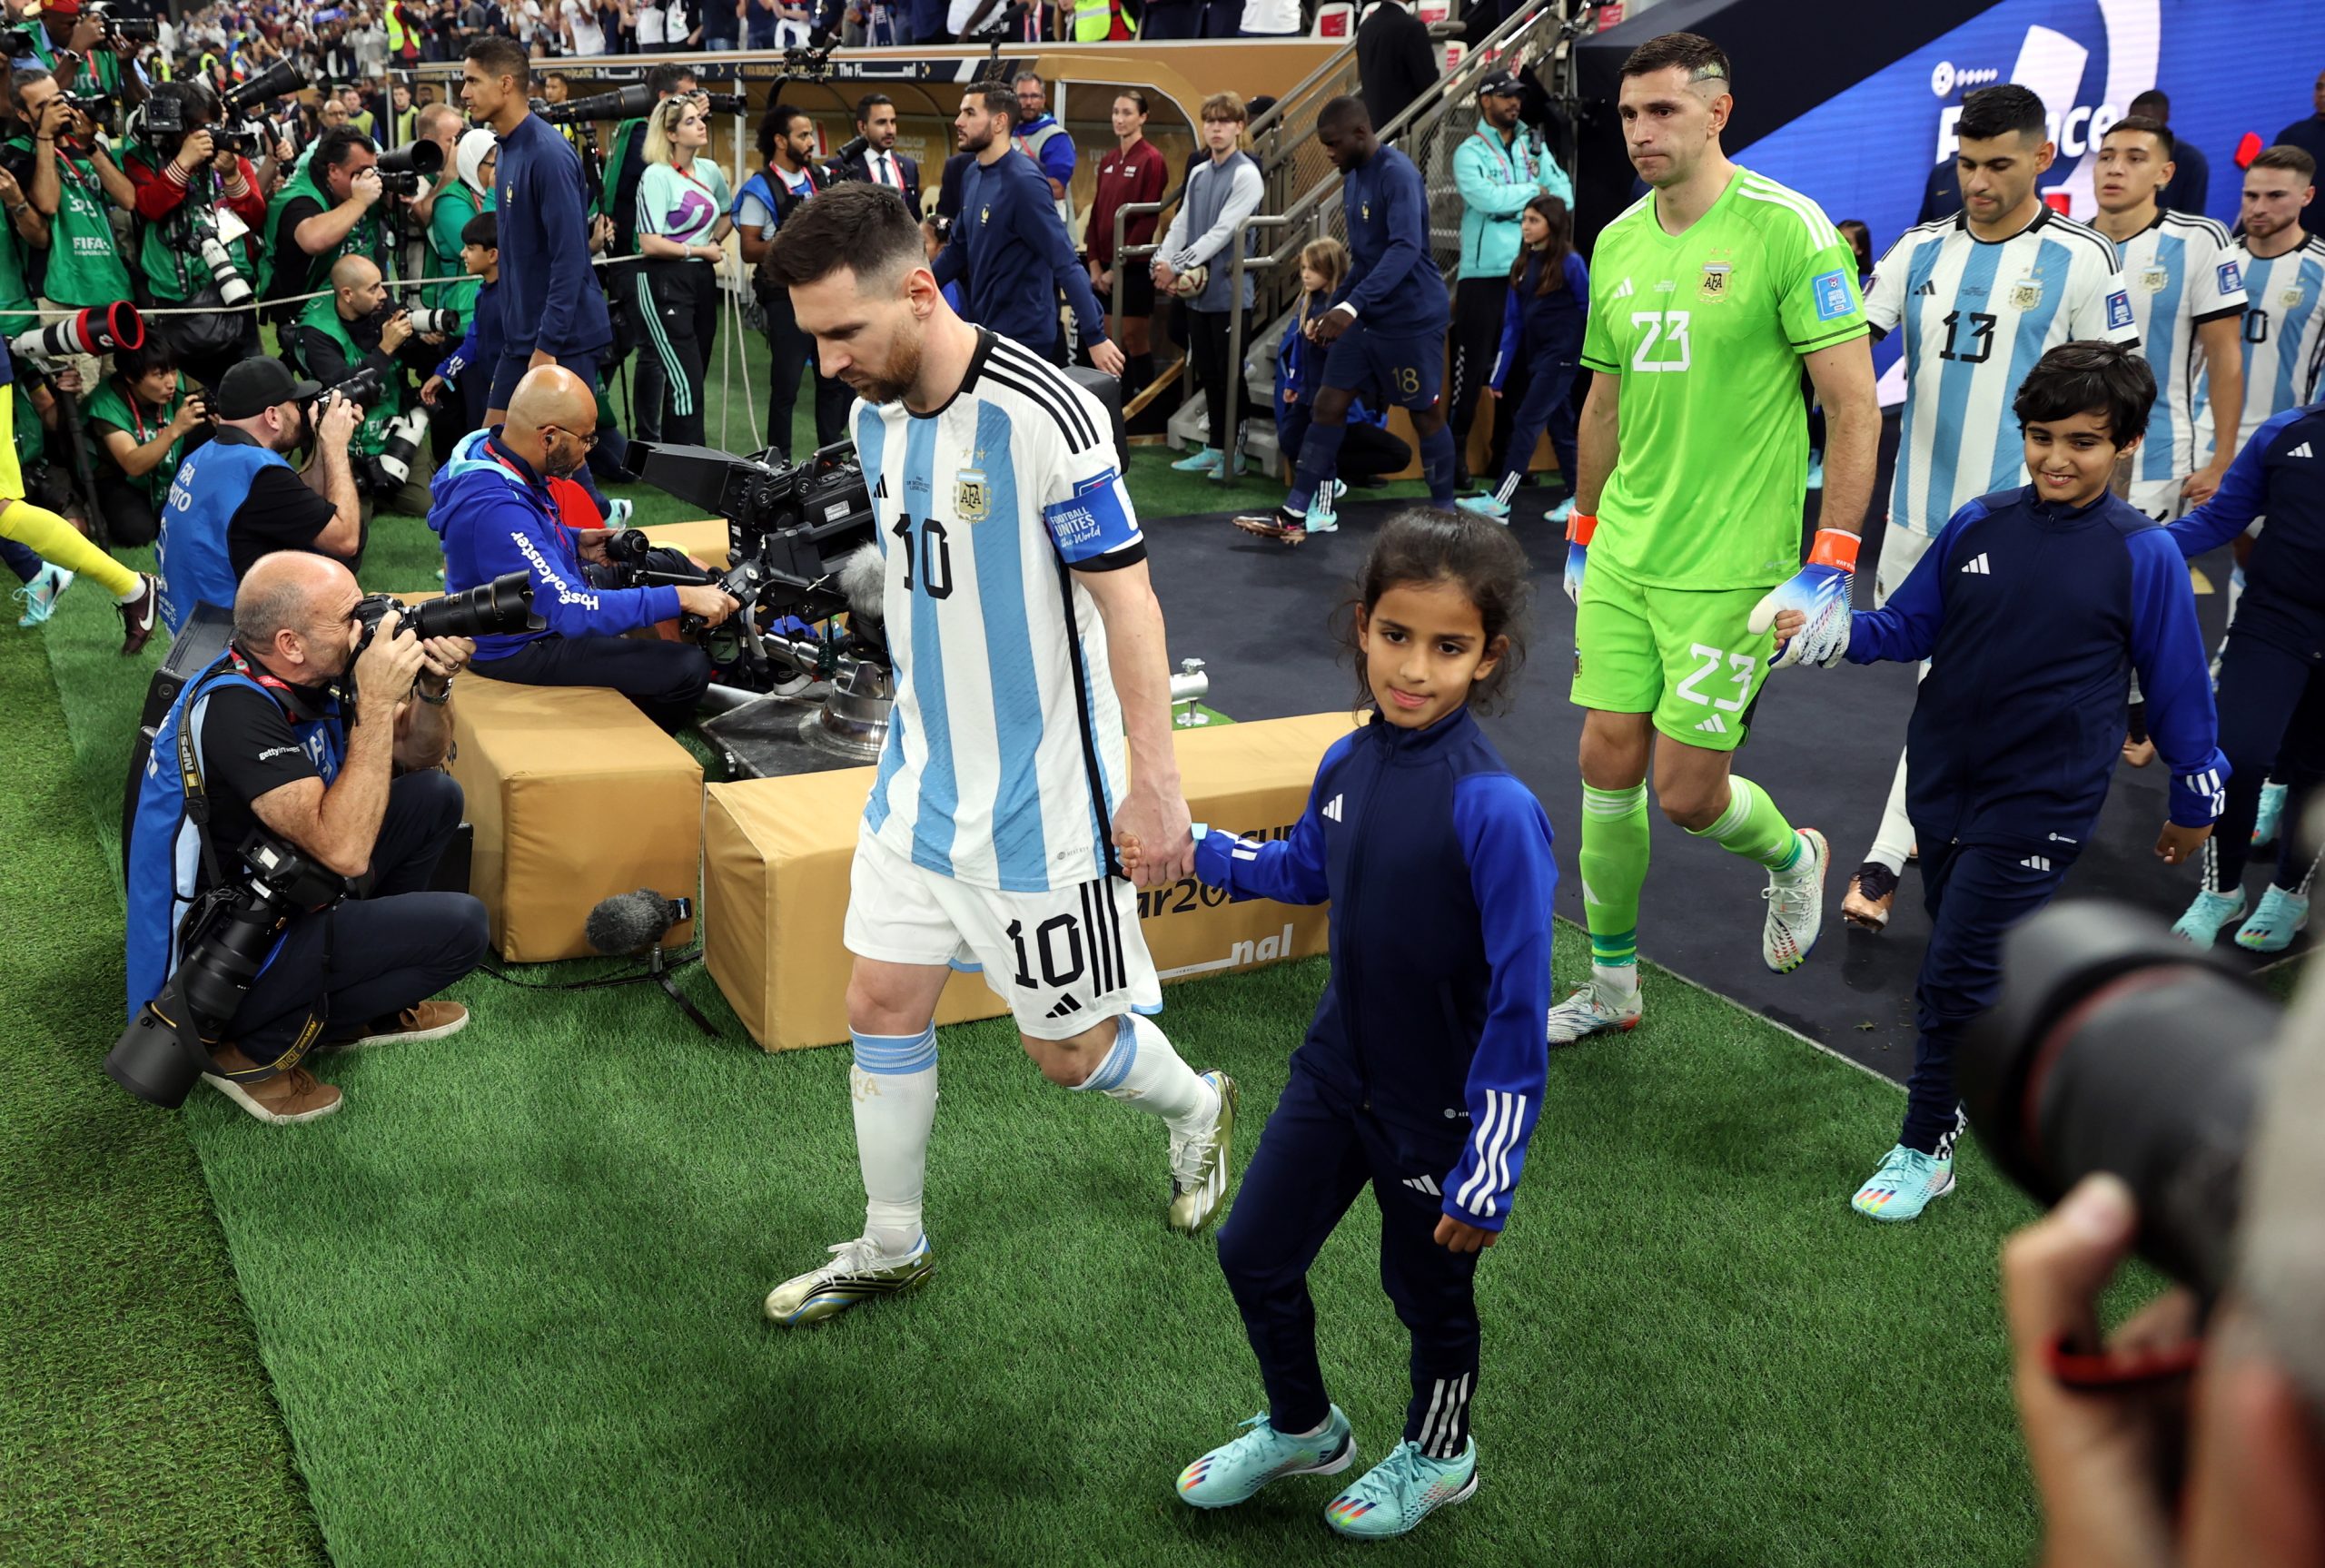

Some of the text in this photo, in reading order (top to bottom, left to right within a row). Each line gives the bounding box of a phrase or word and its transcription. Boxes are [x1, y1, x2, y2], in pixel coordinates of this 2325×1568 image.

[838, 63, 854, 77] The
[73, 237, 104, 249] FIFA
[1631, 311, 1690, 372] 23
[1939, 311, 1997, 363] 13
[1392, 367, 1420, 393] 18
[960, 483, 982, 508] AFA
[1050, 507, 1089, 526] FOOTBALL
[1054, 514, 1095, 537] UNITES
[1060, 525, 1101, 547] the World
[892, 513, 953, 600] 10
[1676, 642, 1756, 712] 23
[180, 735, 194, 771] NPS
[1005, 913, 1084, 990] 10
[1231, 923, 1293, 965] nal
